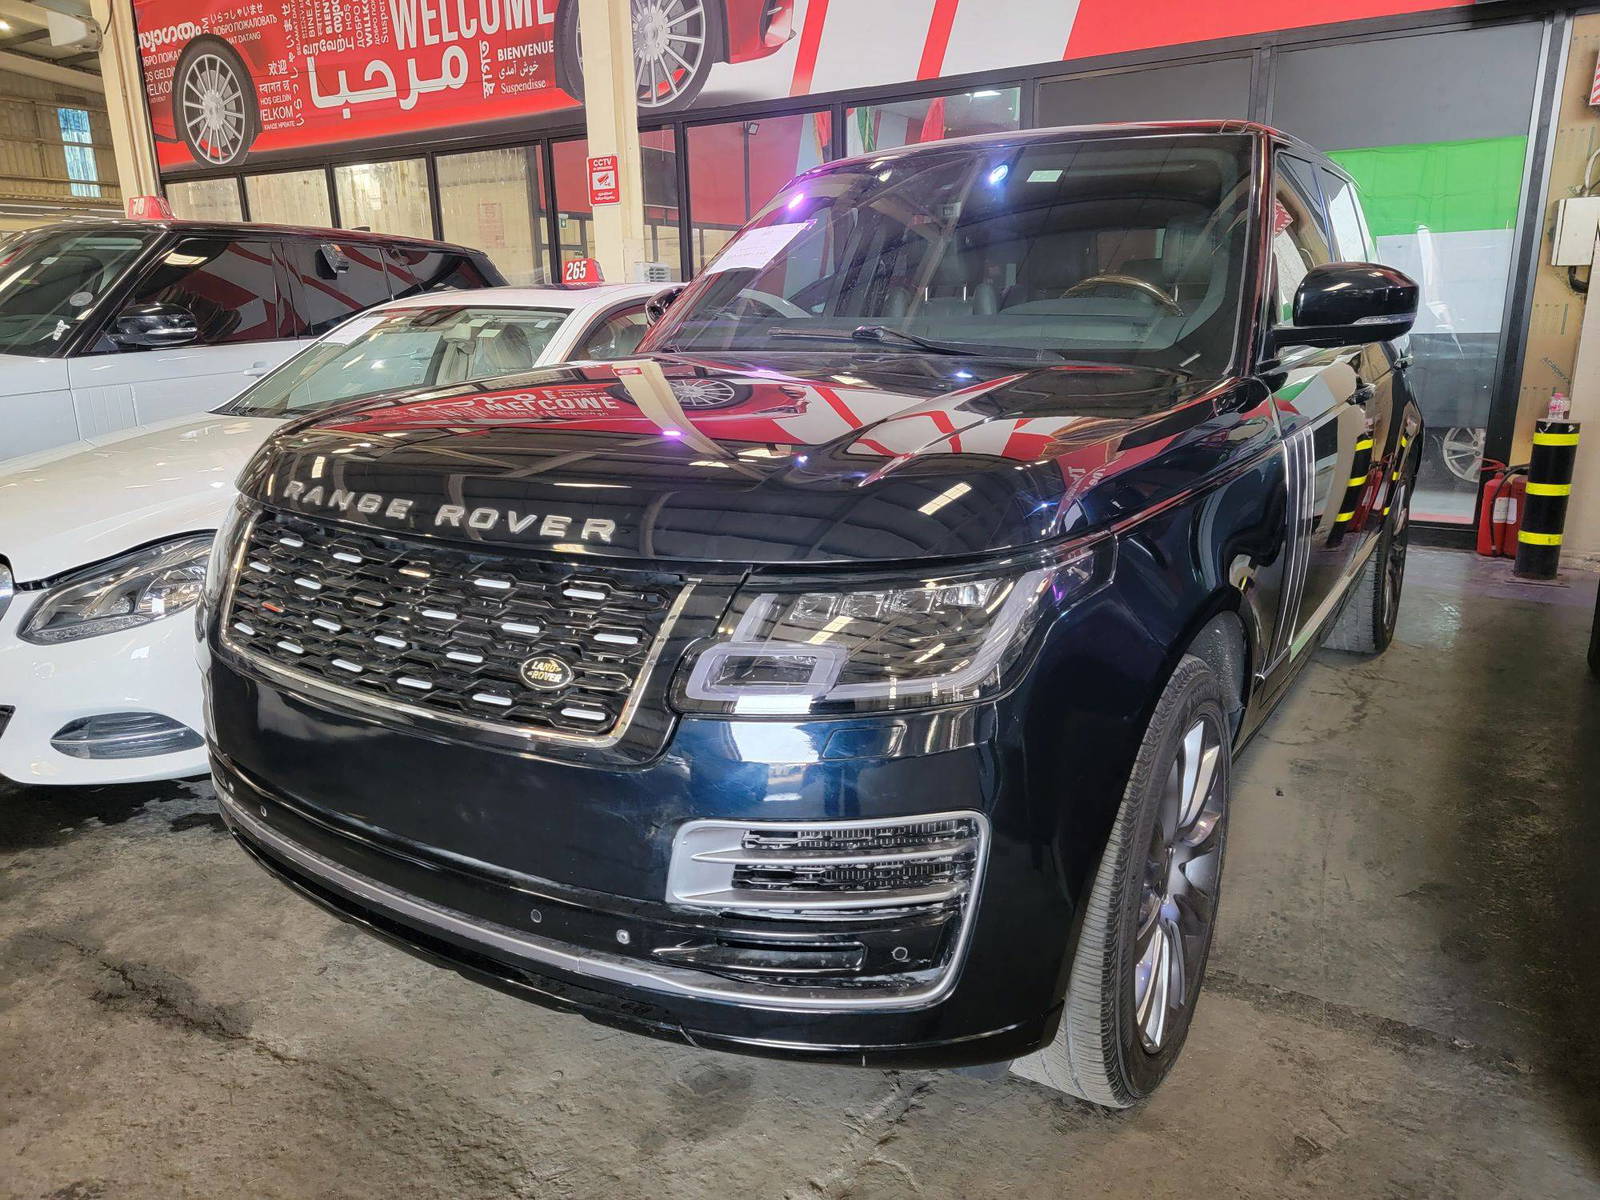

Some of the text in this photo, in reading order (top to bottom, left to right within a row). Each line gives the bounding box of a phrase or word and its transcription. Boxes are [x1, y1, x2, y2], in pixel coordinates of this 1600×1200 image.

[498, 40, 554, 61] BIENVENUE
[307, 45, 468, 119] مرحبا
[501, 78, 547, 95] Suspendisse
[260, 105, 293, 121] ELKOM
[593, 158, 612, 167] CCTV
[566, 261, 587, 280] 265
[283, 480, 617, 543] RANGE ROVER
[532, 660, 557, 672] LAND
[531, 670, 562, 683] ROVER
